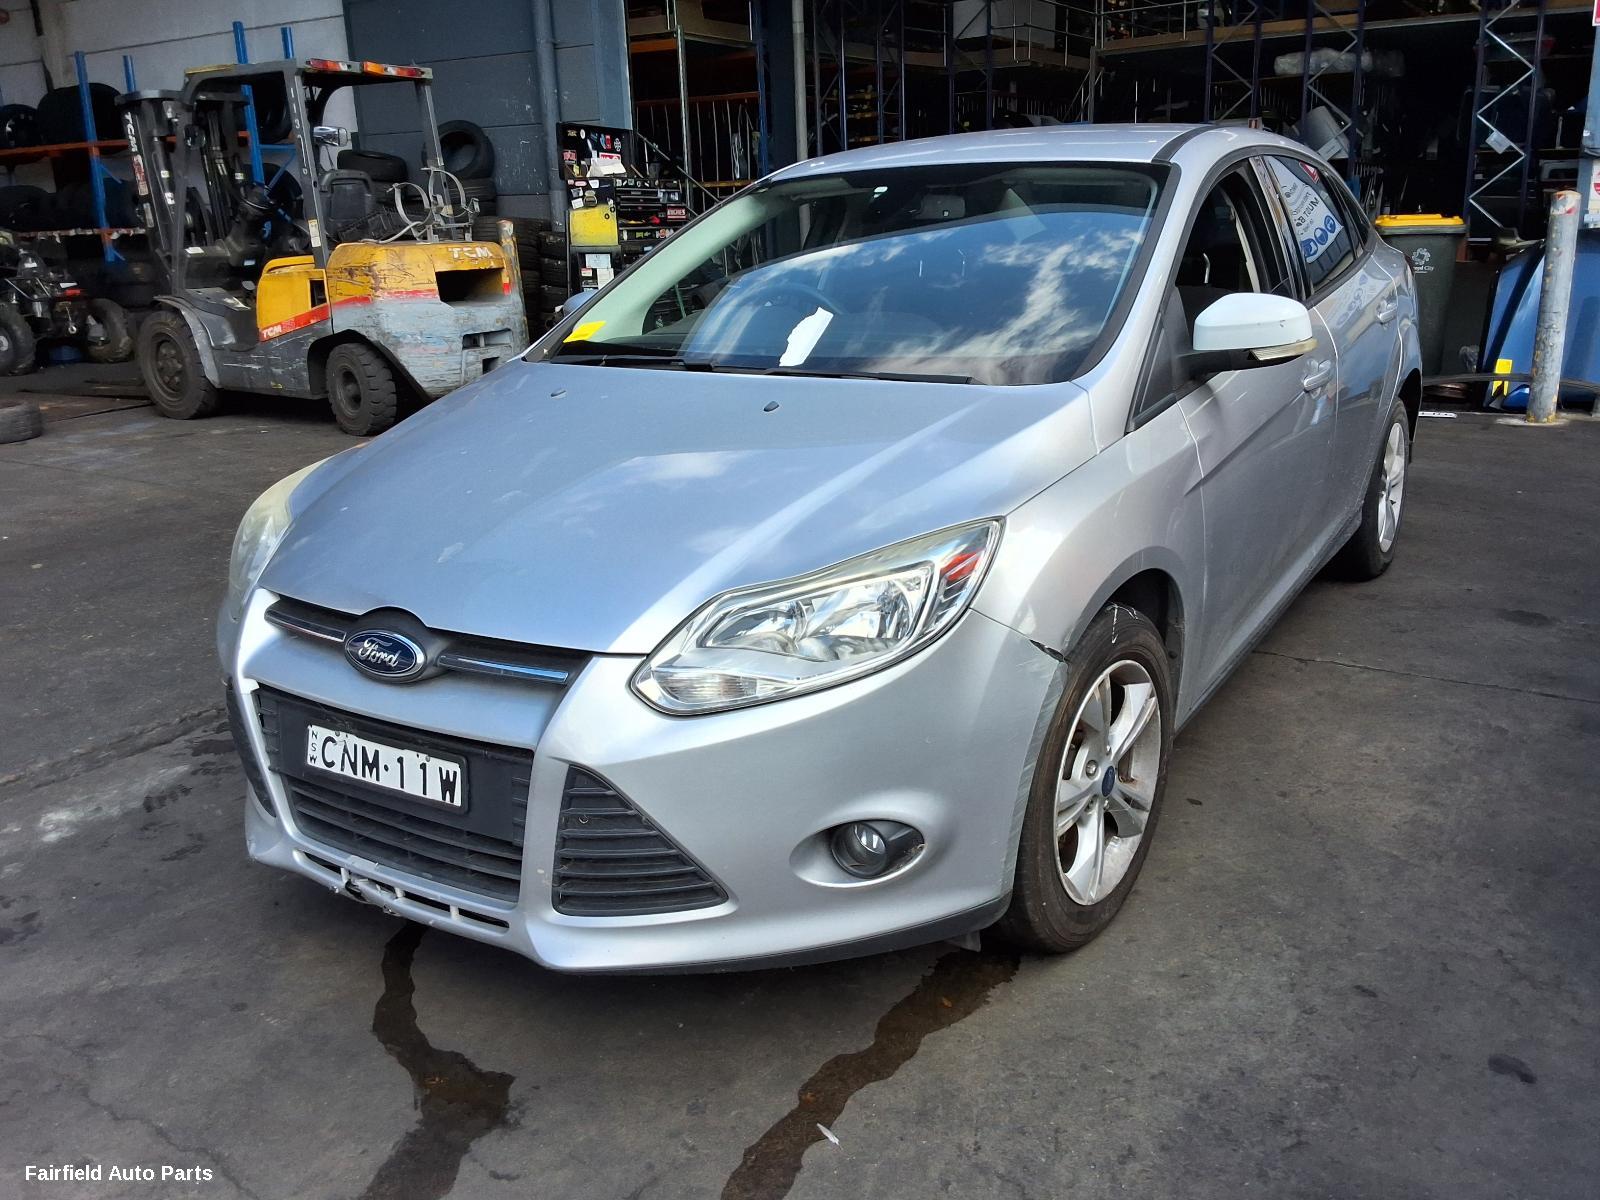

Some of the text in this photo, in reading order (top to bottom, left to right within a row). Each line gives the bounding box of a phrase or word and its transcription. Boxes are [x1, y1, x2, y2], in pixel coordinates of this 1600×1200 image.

[448, 246, 493, 259] TCM
[261, 324, 282, 339] TCM
[358, 638, 400, 667] Ford
